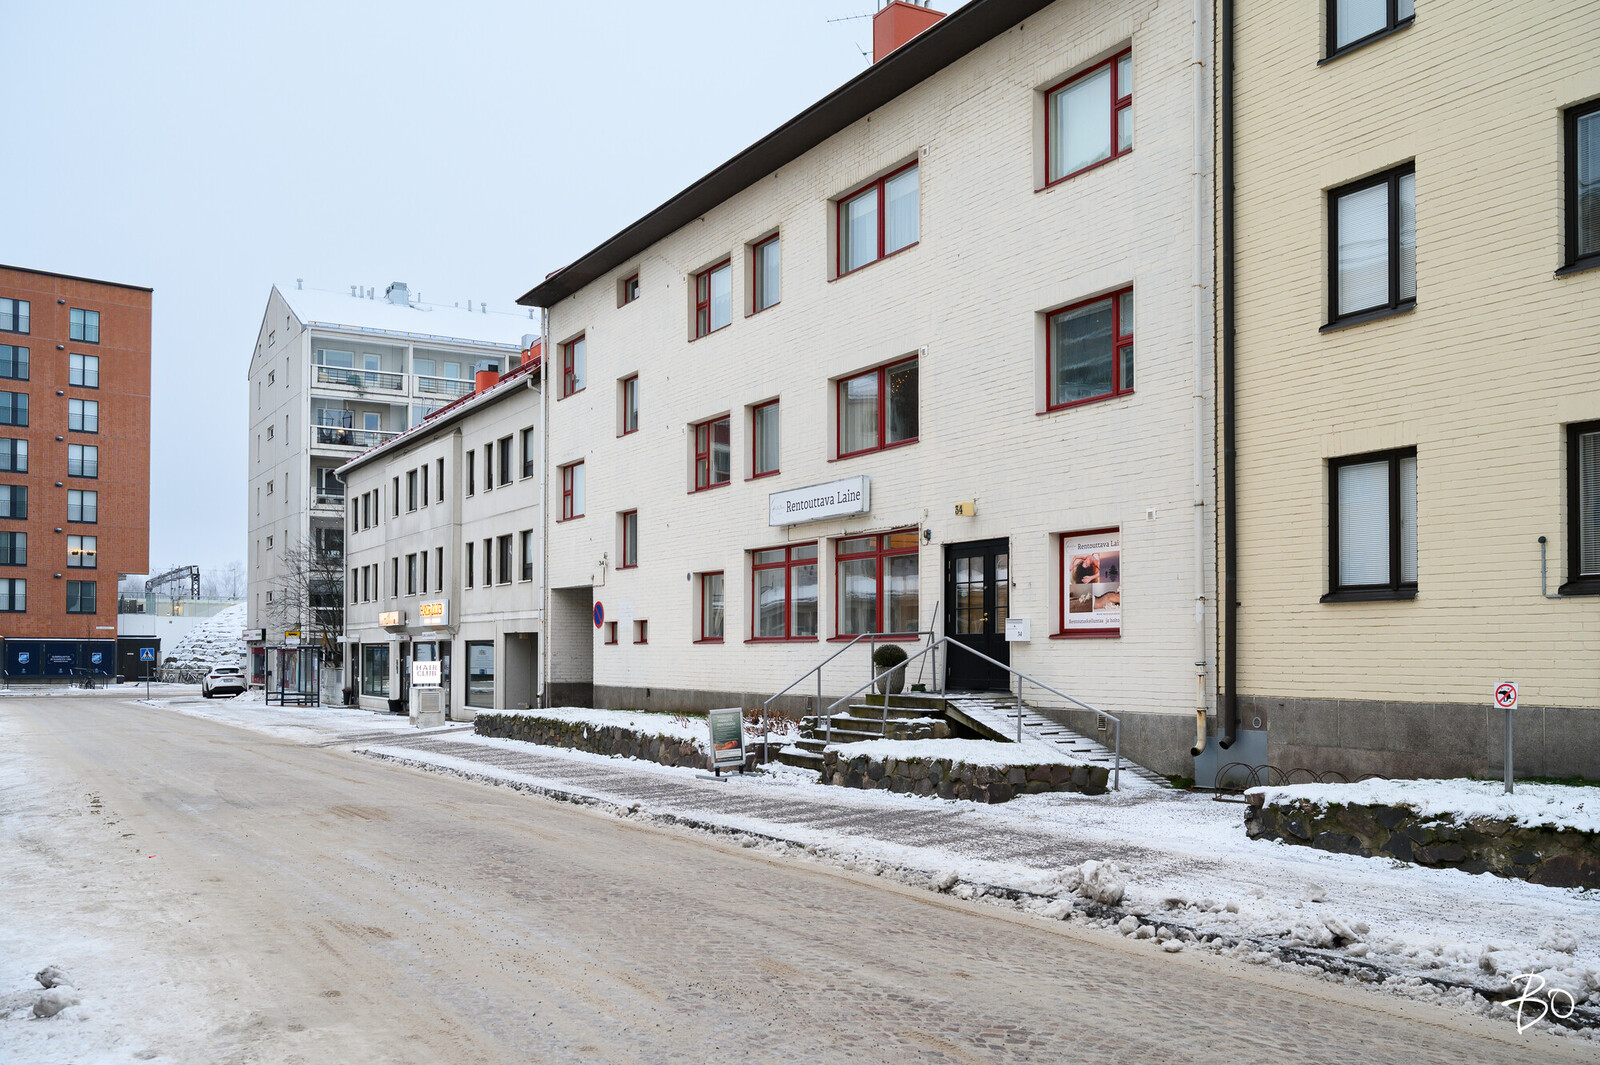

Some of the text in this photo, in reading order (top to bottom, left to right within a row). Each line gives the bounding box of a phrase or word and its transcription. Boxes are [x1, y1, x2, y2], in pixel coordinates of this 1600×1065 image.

[786, 495, 834, 512] Rentouttava
[837, 489, 861, 504] Laine
[955, 504, 963, 515] 34
[1077, 542, 1110, 550] Rentouttava
